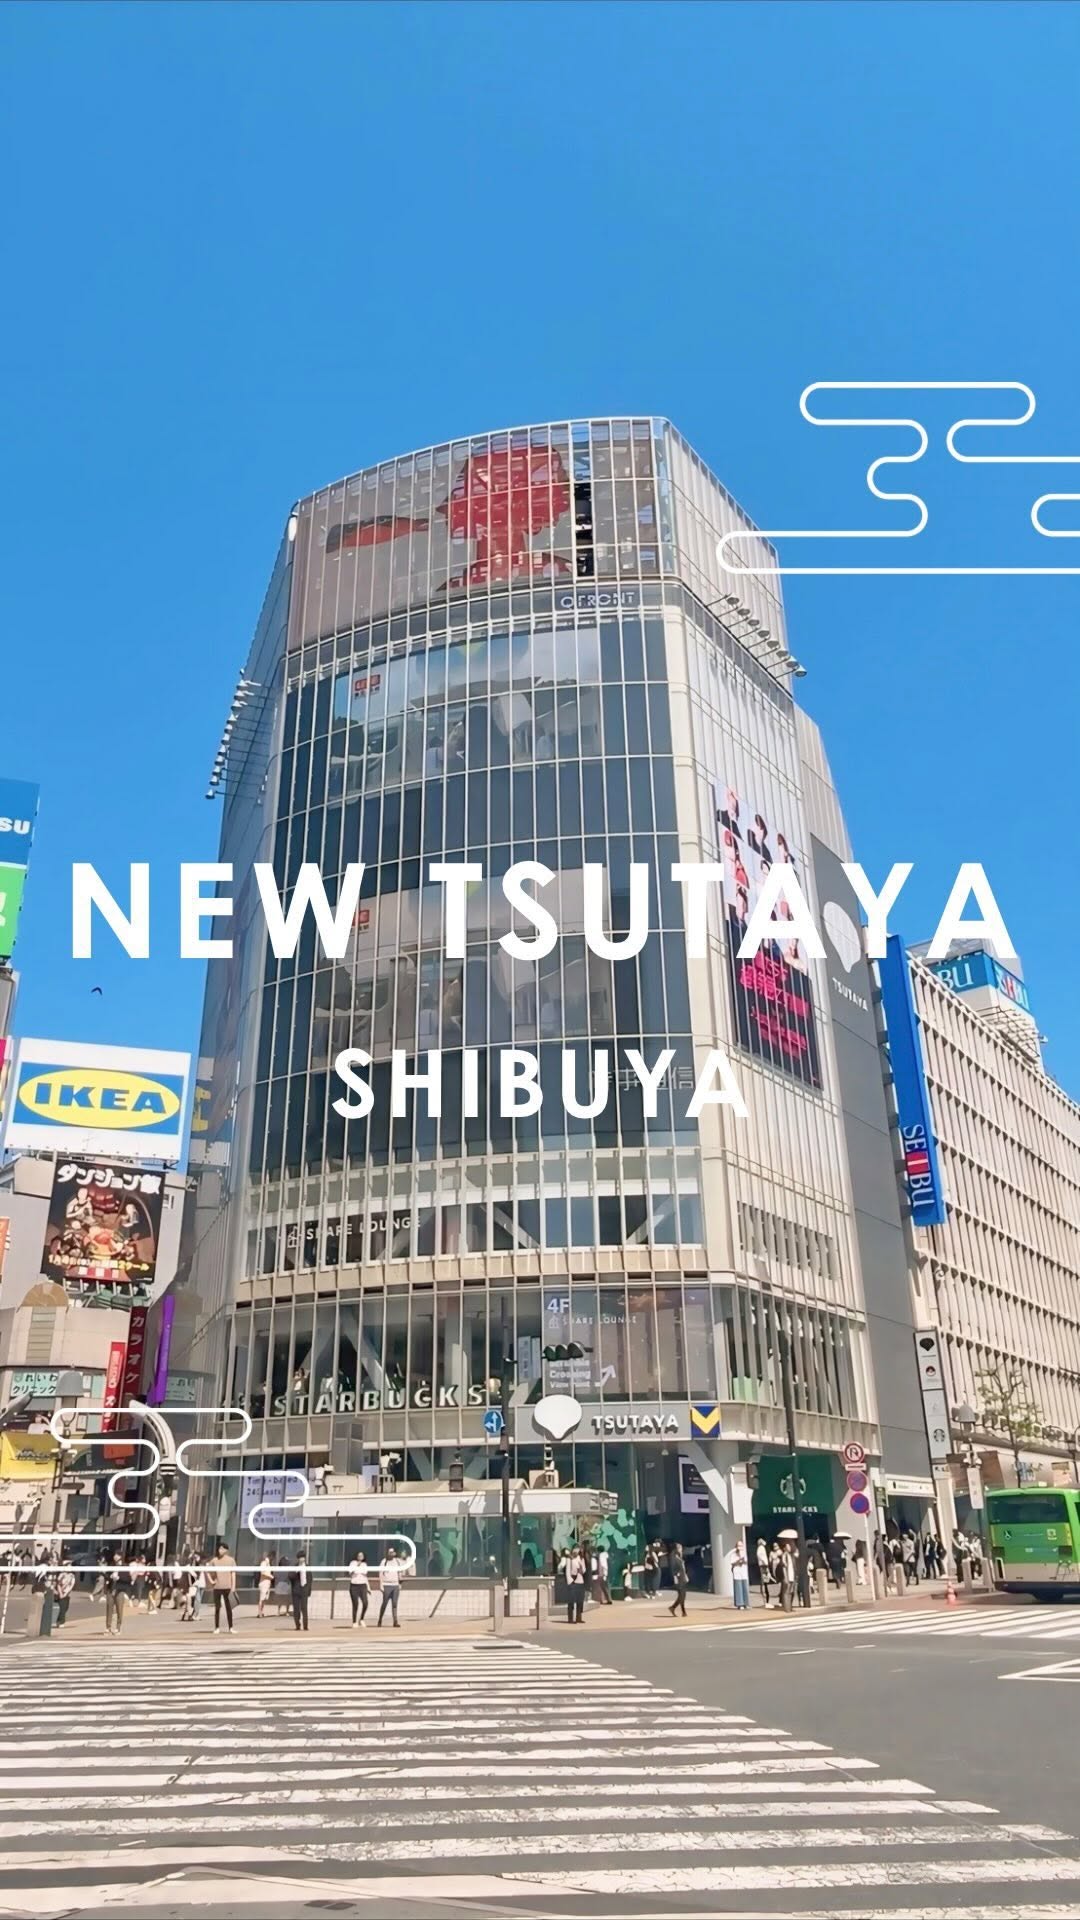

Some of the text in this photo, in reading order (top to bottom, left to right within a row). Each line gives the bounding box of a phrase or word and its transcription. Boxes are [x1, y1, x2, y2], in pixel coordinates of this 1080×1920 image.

[560, 592, 635, 608] QFRONT
[832, 977, 869, 1012] TSUTAYA
[35, 1082, 167, 1114] IKEA
[903, 1124, 935, 1207] SEIBU
[547, 1298, 571, 1314] 4F
[562, 1315, 636, 1325] SARE LOUNE
[125, 1315, 145, 1383] カラオケ
[25, 1372, 58, 1383] れいわ
[274, 1384, 484, 1416] STARBUCKS
[592, 1414, 679, 1430] TSUTAYA
[772, 1506, 819, 1514] STARCKS
